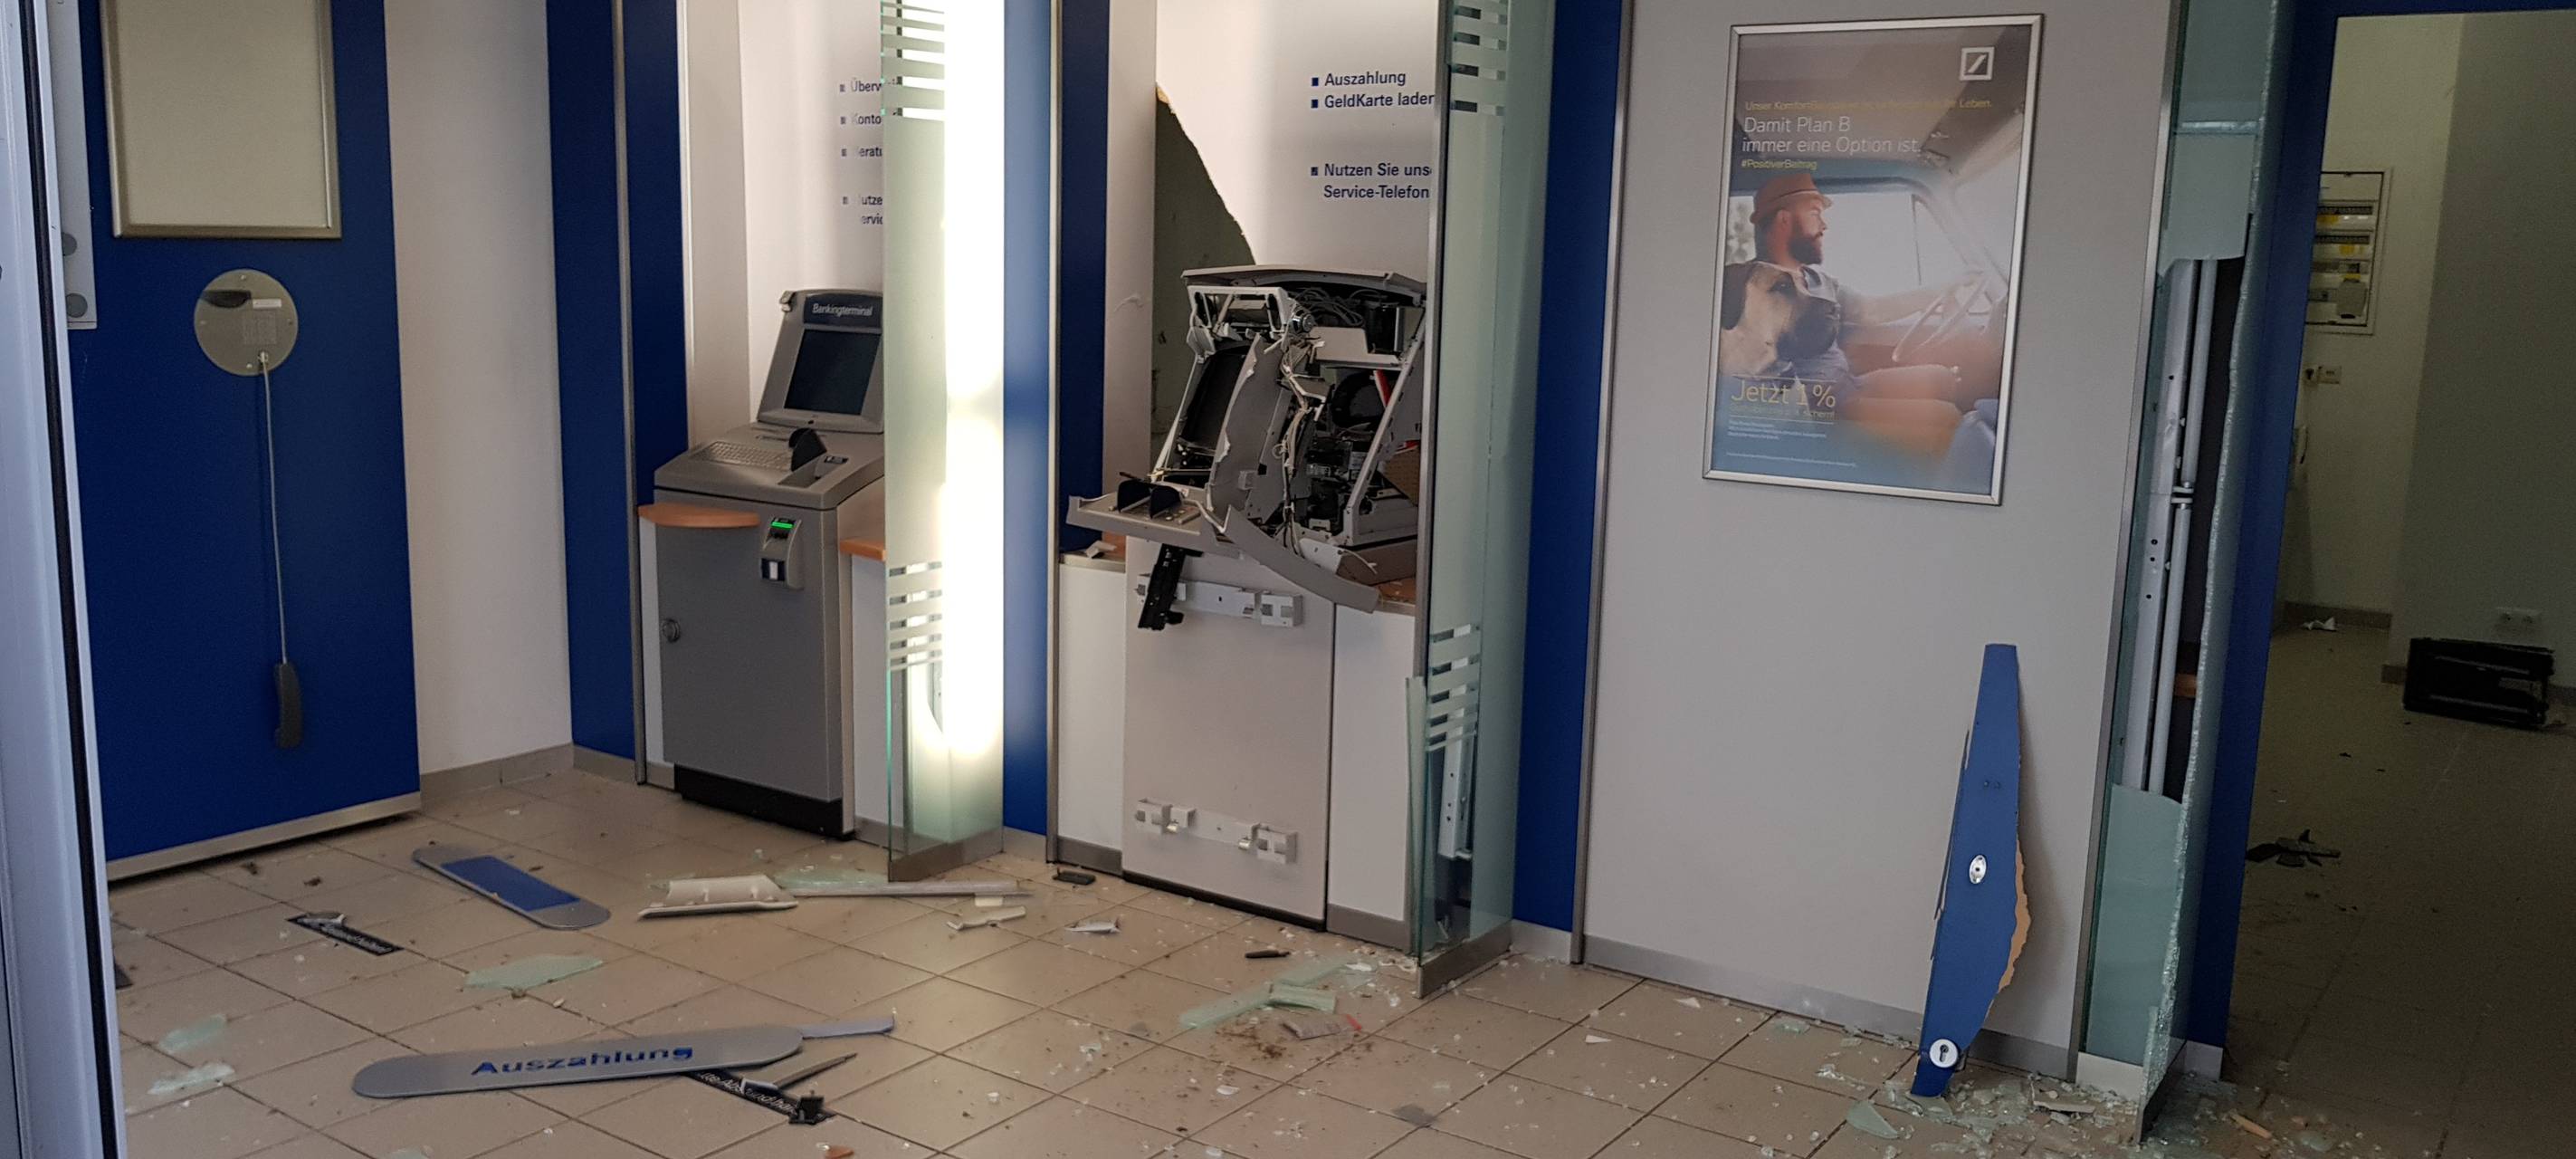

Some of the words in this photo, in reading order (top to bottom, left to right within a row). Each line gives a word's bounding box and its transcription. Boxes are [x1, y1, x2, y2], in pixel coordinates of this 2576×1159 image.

[1324, 71, 1407, 86] Auszahlung
[1324, 94, 1394, 108] GeldKarte
[853, 113, 882, 125] onto
[1743, 116, 1792, 133] Damit
[1797, 116, 1833, 133] Plan
[1838, 115, 1851, 132] B
[856, 147, 883, 158] erat
[1741, 137, 1792, 152] immer
[1797, 138, 1831, 152] eine
[1836, 136, 1892, 156] Option
[1324, 163, 1373, 177] Nutzen
[1377, 162, 1399, 176] Sie
[1404, 166, 1432, 176] uns
[1323, 185, 1429, 198] Service-Telefon
[812, 302, 873, 317] Bankingterminal
[1731, 379, 1789, 405] Jetzt
[471, 1046, 693, 1076] Auszahlung
